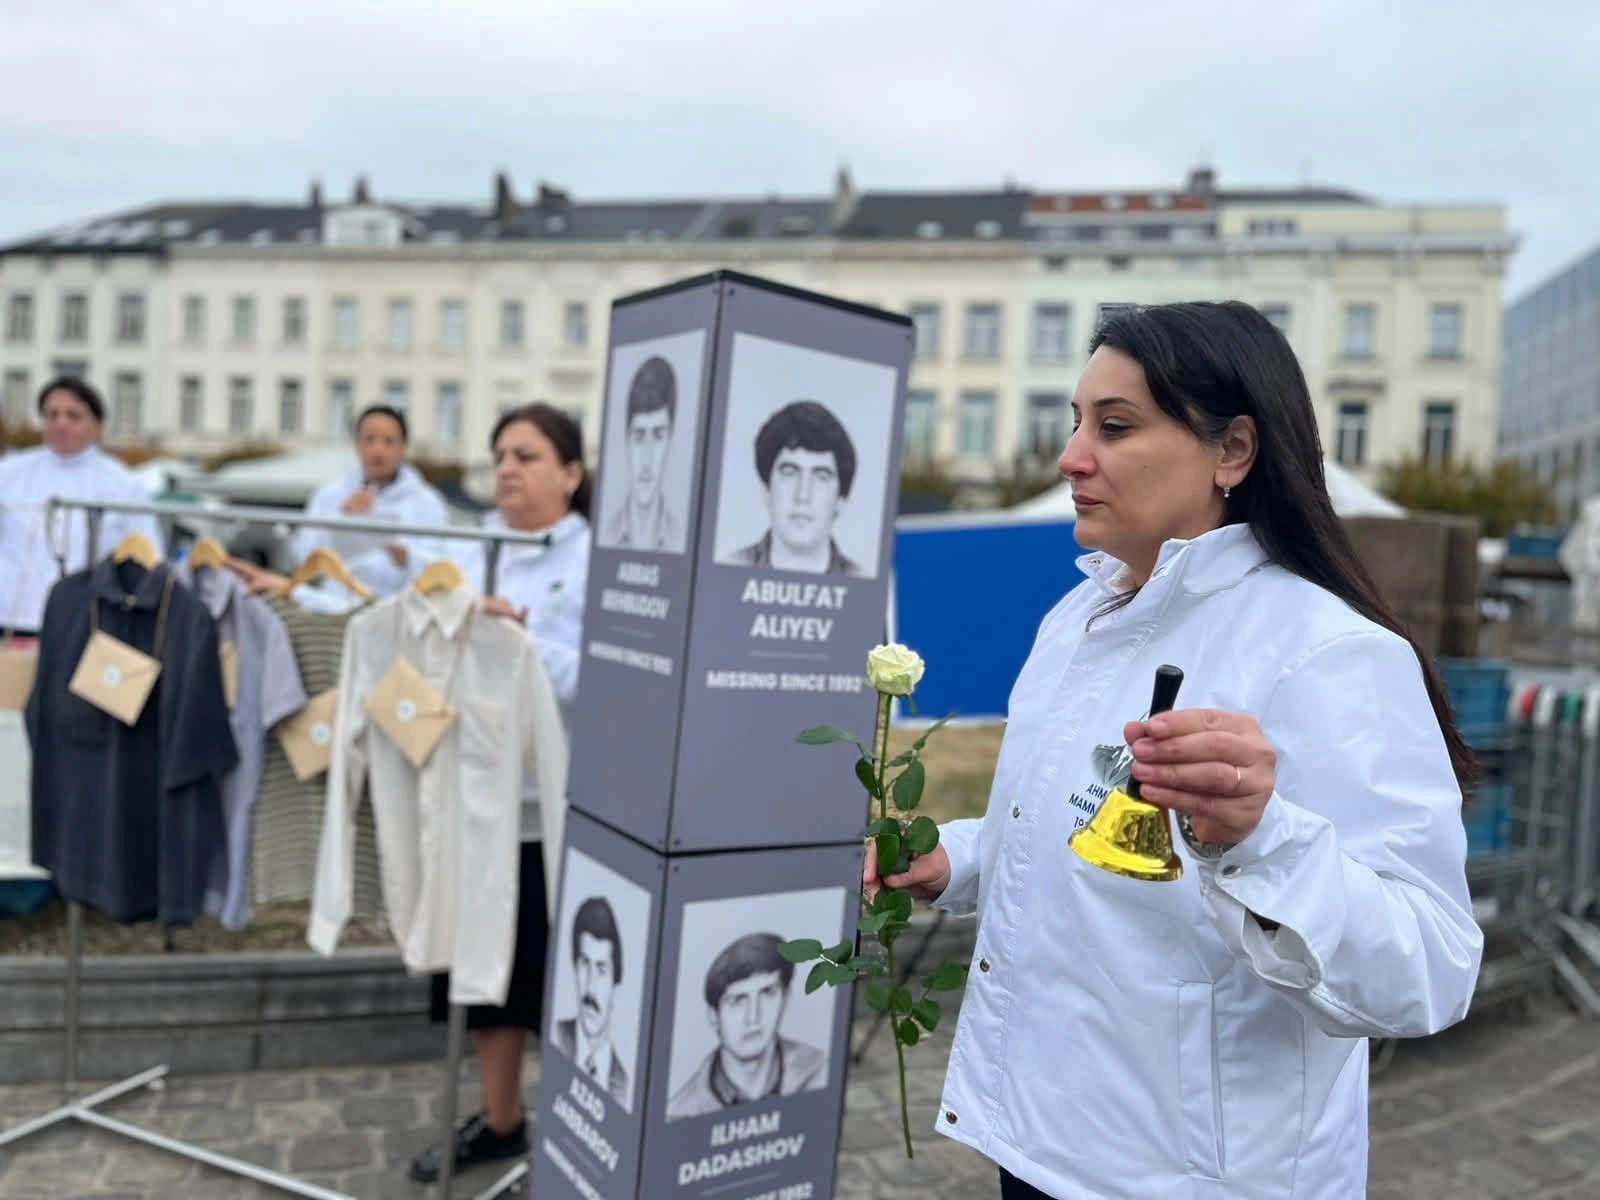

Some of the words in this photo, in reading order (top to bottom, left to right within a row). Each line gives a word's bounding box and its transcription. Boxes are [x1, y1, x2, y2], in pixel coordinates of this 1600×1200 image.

[742, 579, 848, 609] ABULFAT
[751, 614, 833, 641] ALIYEV
[706, 670, 777, 689] MISSING
[779, 674, 825, 691] SINCE
[1086, 783, 1108, 799] AHM
[711, 1111, 781, 1147] ILHAM
[678, 1133, 806, 1185] DADASHOV
